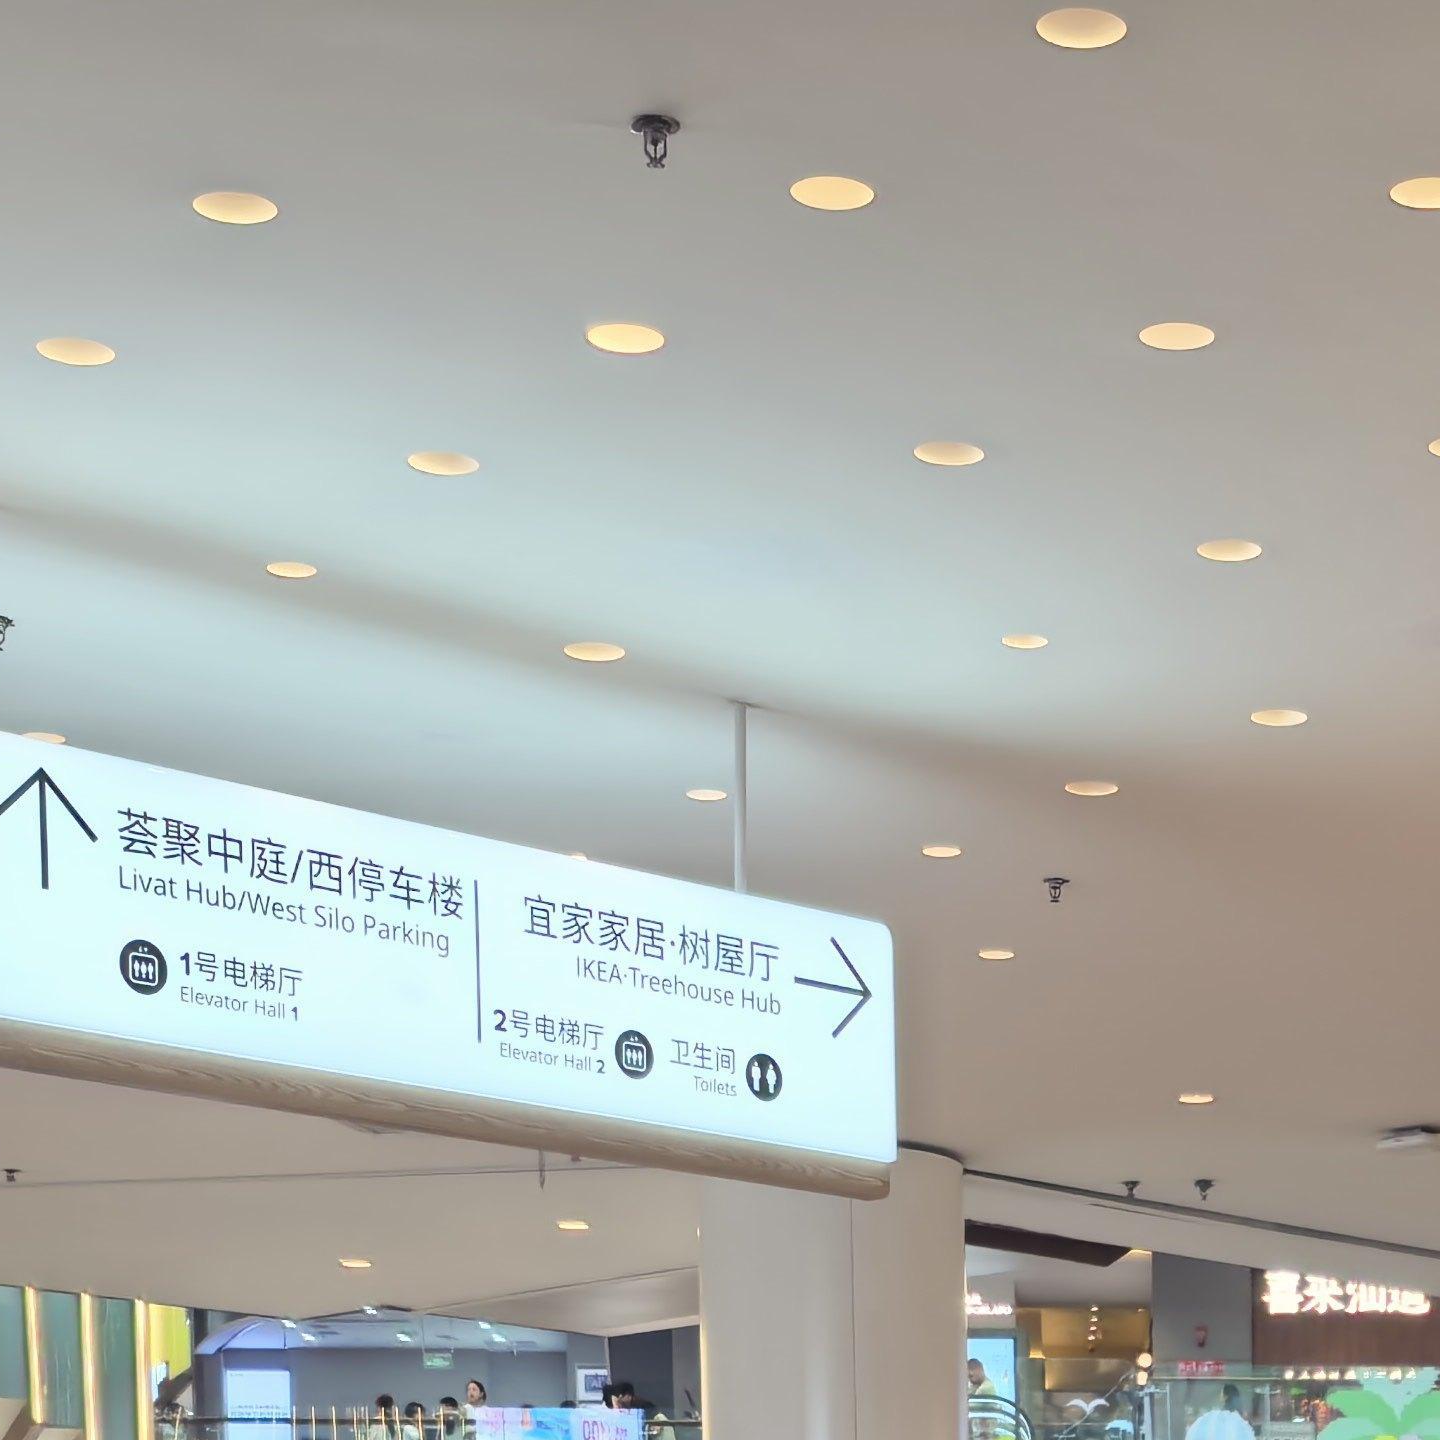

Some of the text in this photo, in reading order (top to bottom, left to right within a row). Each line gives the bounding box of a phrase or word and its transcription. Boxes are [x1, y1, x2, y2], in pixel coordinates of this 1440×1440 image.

[116, 807, 465, 920] 荟聚中庭/西停车楼
[118, 865, 450, 959] Livat Hub/West Silo Parking
[523, 893, 780, 982] 宜家家居·树屋厅
[178, 950, 304, 998] 1号电梯厅
[178, 985, 299, 1021] Elevator Hall 1
[741, 988, 782, 1016] Hub
[492, 1008, 605, 1050] 2号电梯厅
[499, 1042, 606, 1074] Elevator Hall 2
[669, 1037, 737, 1075] 卫生间
[693, 1075, 738, 1097] Toilets
